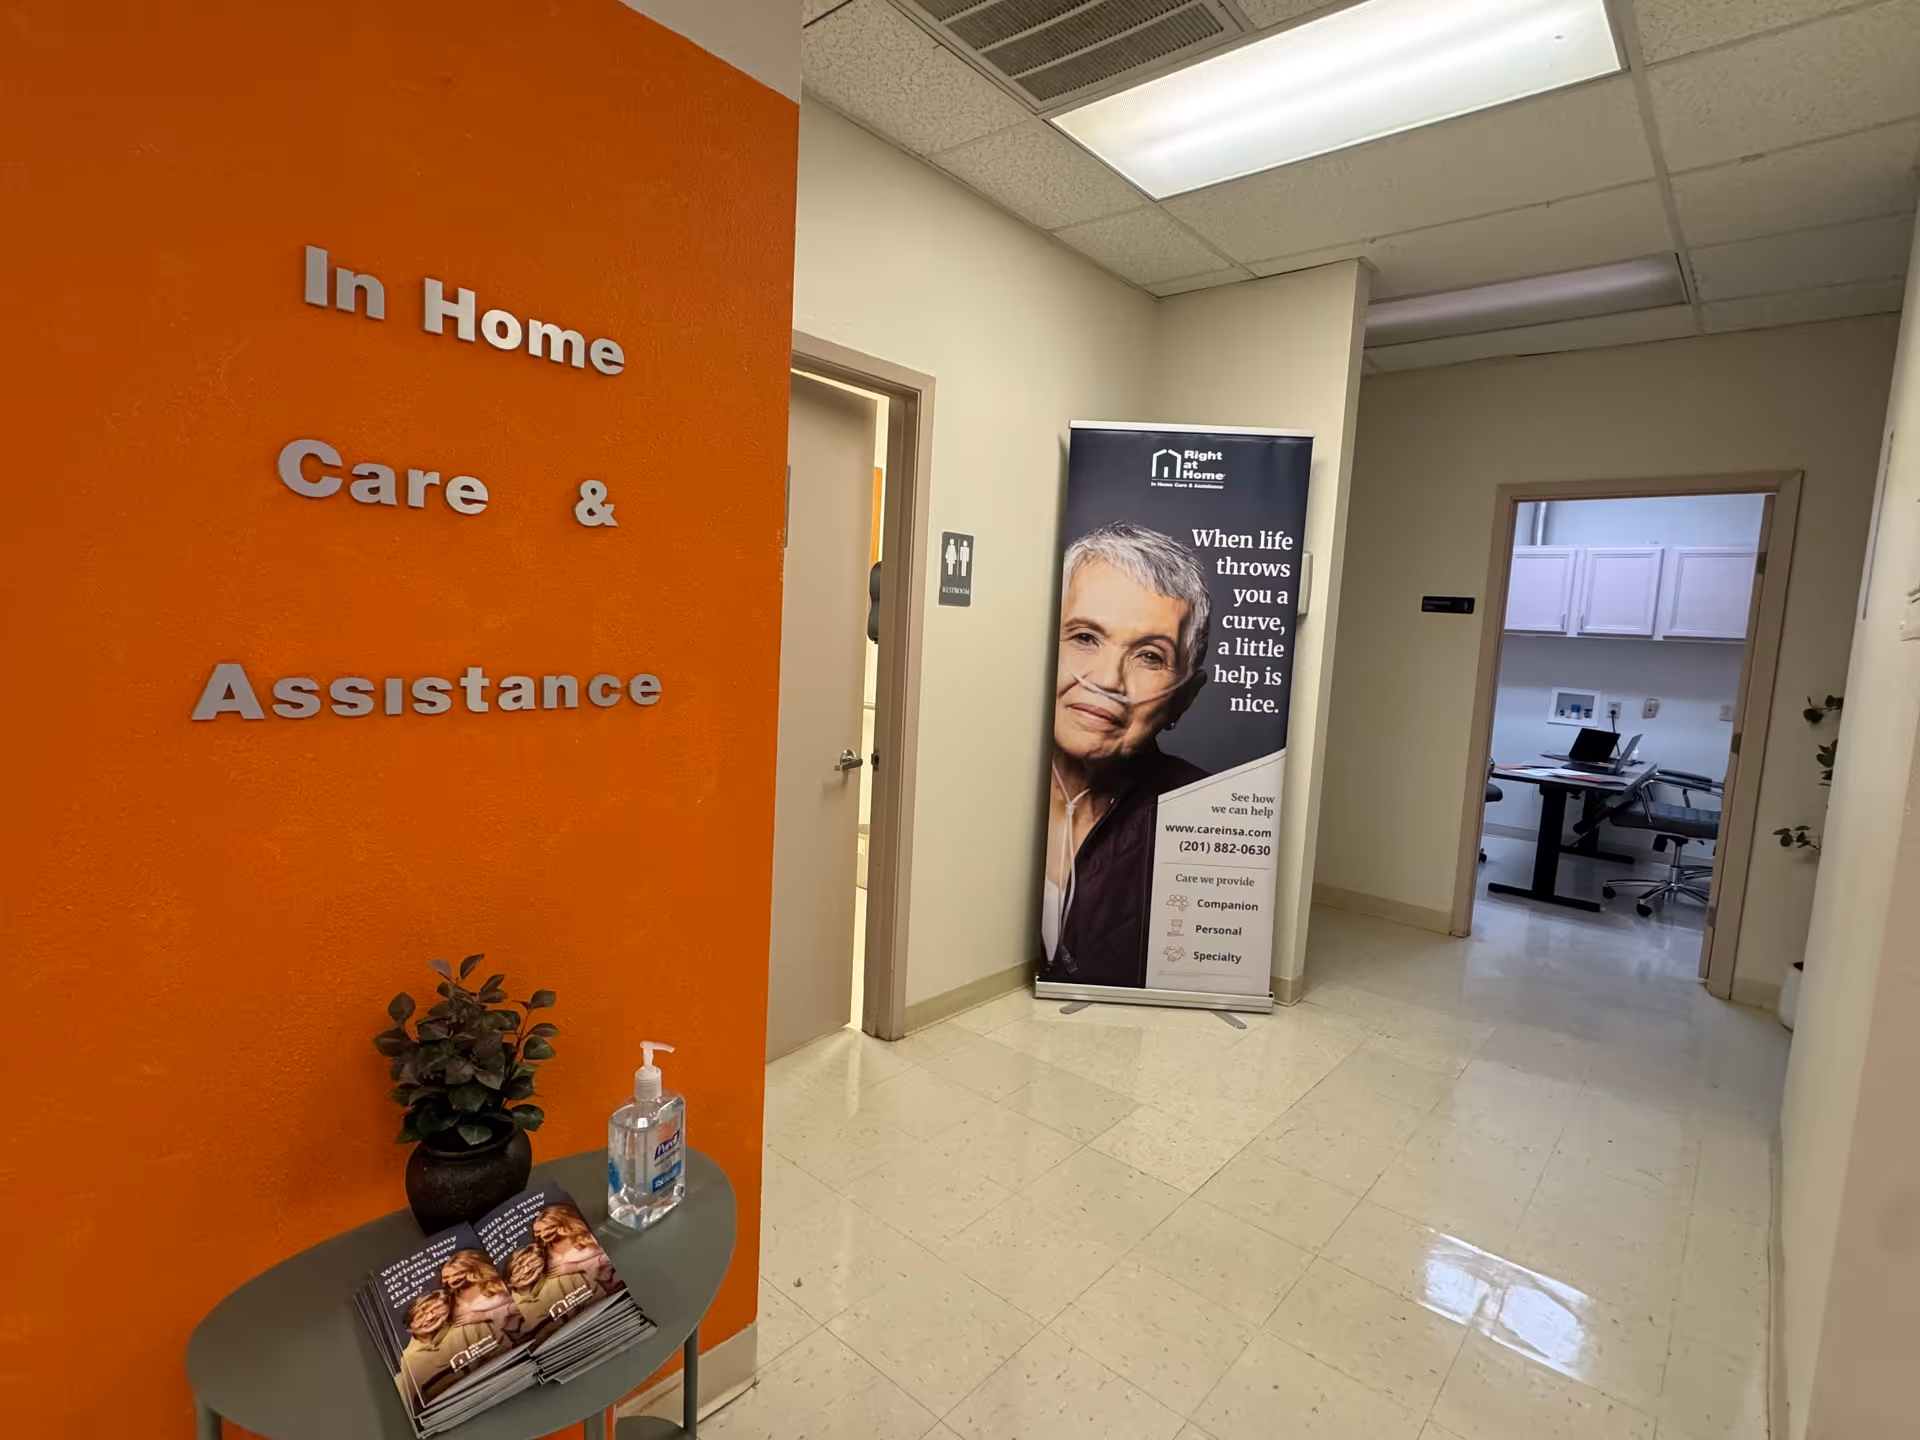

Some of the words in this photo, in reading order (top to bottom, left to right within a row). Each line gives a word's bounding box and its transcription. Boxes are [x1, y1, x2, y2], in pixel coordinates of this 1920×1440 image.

[305, 245, 385, 320] In
[424, 277, 625, 376] Home
[1183, 461, 1198, 469] at
[1184, 450, 1223, 462] Right
[278, 439, 489, 515] Care
[574, 480, 618, 527] &
[1182, 470, 1225, 480] Home
[1192, 529, 1253, 549] When
[1259, 531, 1293, 550] life
[1216, 556, 1291, 577] throws
[1233, 589, 1272, 607] you
[1277, 590, 1289, 605] a
[1222, 615, 1285, 635] curve,
[1217, 641, 1230, 655] a
[1235, 637, 1284, 657] little
[1213, 664, 1259, 689] help
[1264, 666, 1282, 685] is
[191, 663, 662, 721] Assistance
[1230, 693, 1279, 713] nice.
[1231, 792, 1250, 802] See
[1252, 793, 1275, 804] how
[1211, 806, 1226, 814] we
[1228, 807, 1248, 815] can
[1251, 806, 1274, 818] help
[1165, 824, 1272, 838] www.careinsa.com
[1179, 841, 1211, 854] (201)
[1213, 843, 1271, 856] 882-0630
[1175, 873, 1198, 883] Care
[1200, 876, 1214, 884] we
[1216, 876, 1255, 887] provide
[1197, 899, 1259, 911] Companion
[1195, 924, 1242, 936] Personal
[1193, 951, 1242, 964] Specialty
[478, 1217, 502, 1236] With
[503, 1208, 515, 1217] so
[516, 1192, 545, 1209] many
[523, 1200, 545, 1214] how
[485, 1239, 498, 1251] do
[505, 1211, 541, 1235] choose
[432, 1244, 456, 1258] how
[489, 1243, 506, 1258] the
[506, 1227, 528, 1243] best
[380, 1259, 409, 1277] With
[411, 1252, 424, 1261] so
[425, 1236, 457, 1253] many
[493, 1241, 518, 1265] care?
[387, 1282, 402, 1293] do
[411, 1256, 450, 1278] choose
[390, 1286, 410, 1301] the
[411, 1271, 436, 1288] best
[393, 1286, 423, 1309] care?
